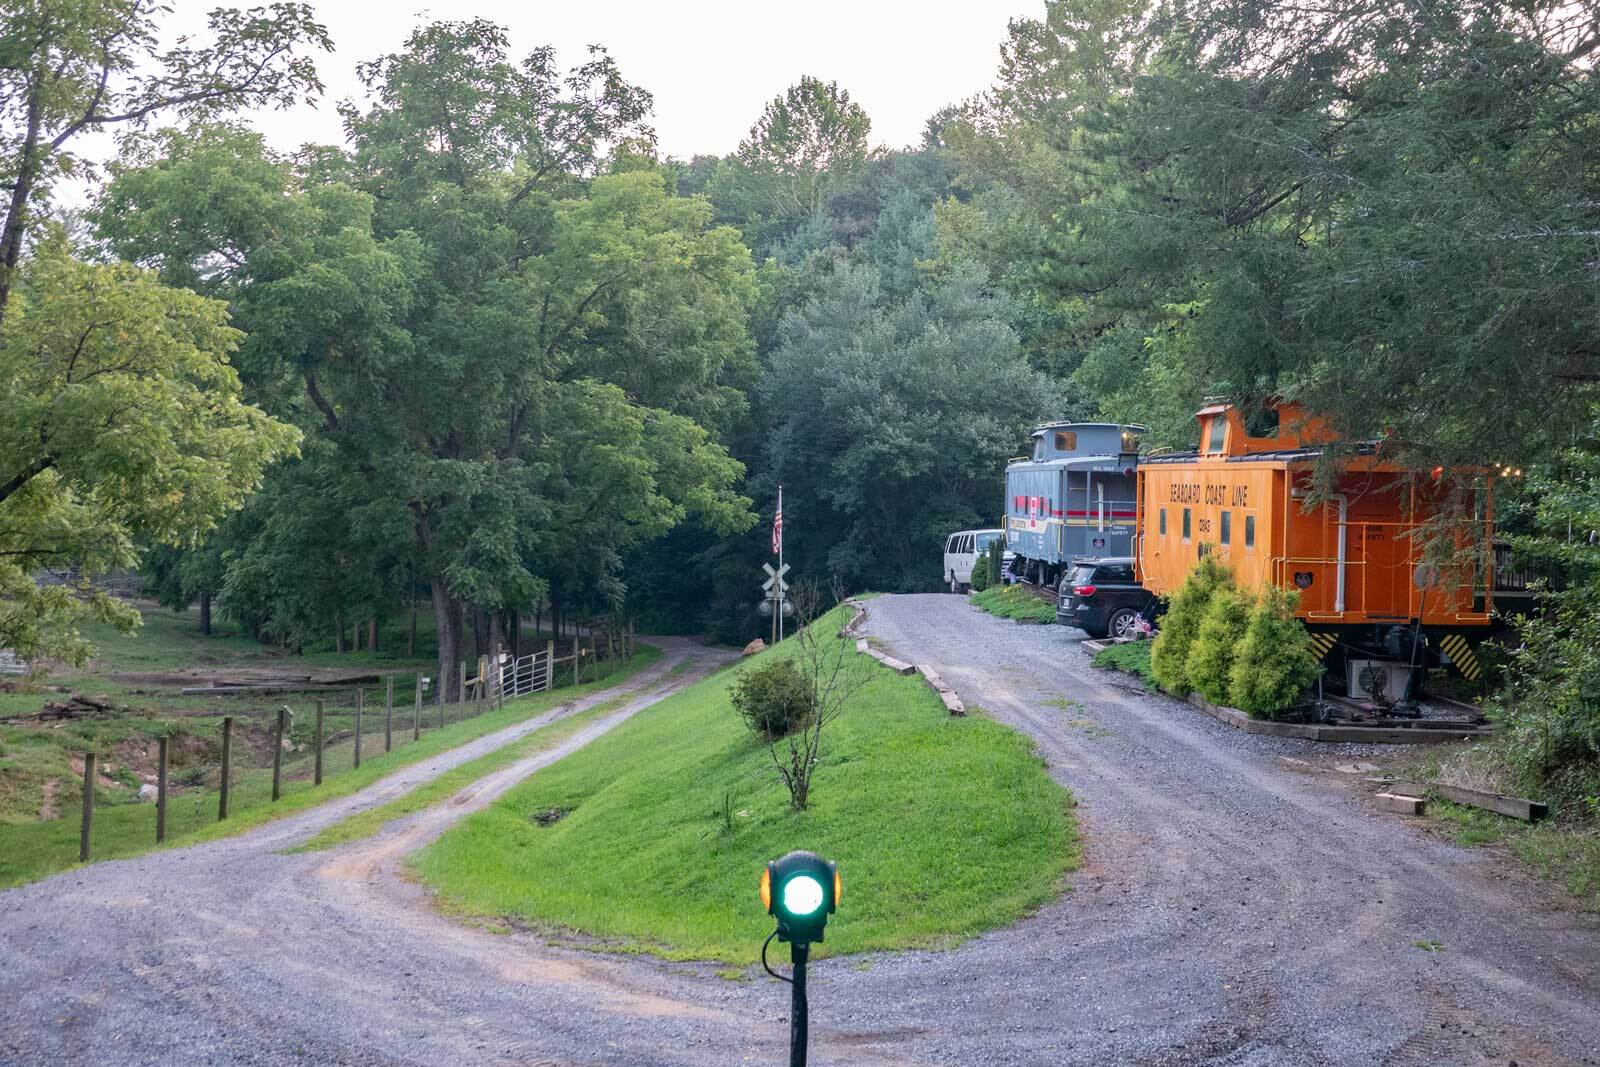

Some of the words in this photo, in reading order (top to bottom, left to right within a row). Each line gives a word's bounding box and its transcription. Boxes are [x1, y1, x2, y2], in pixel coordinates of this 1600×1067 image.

[1170, 483, 1201, 504] SEABOARD
[1205, 484, 1226, 506] COAST
[1231, 485, 1248, 507] LINE
